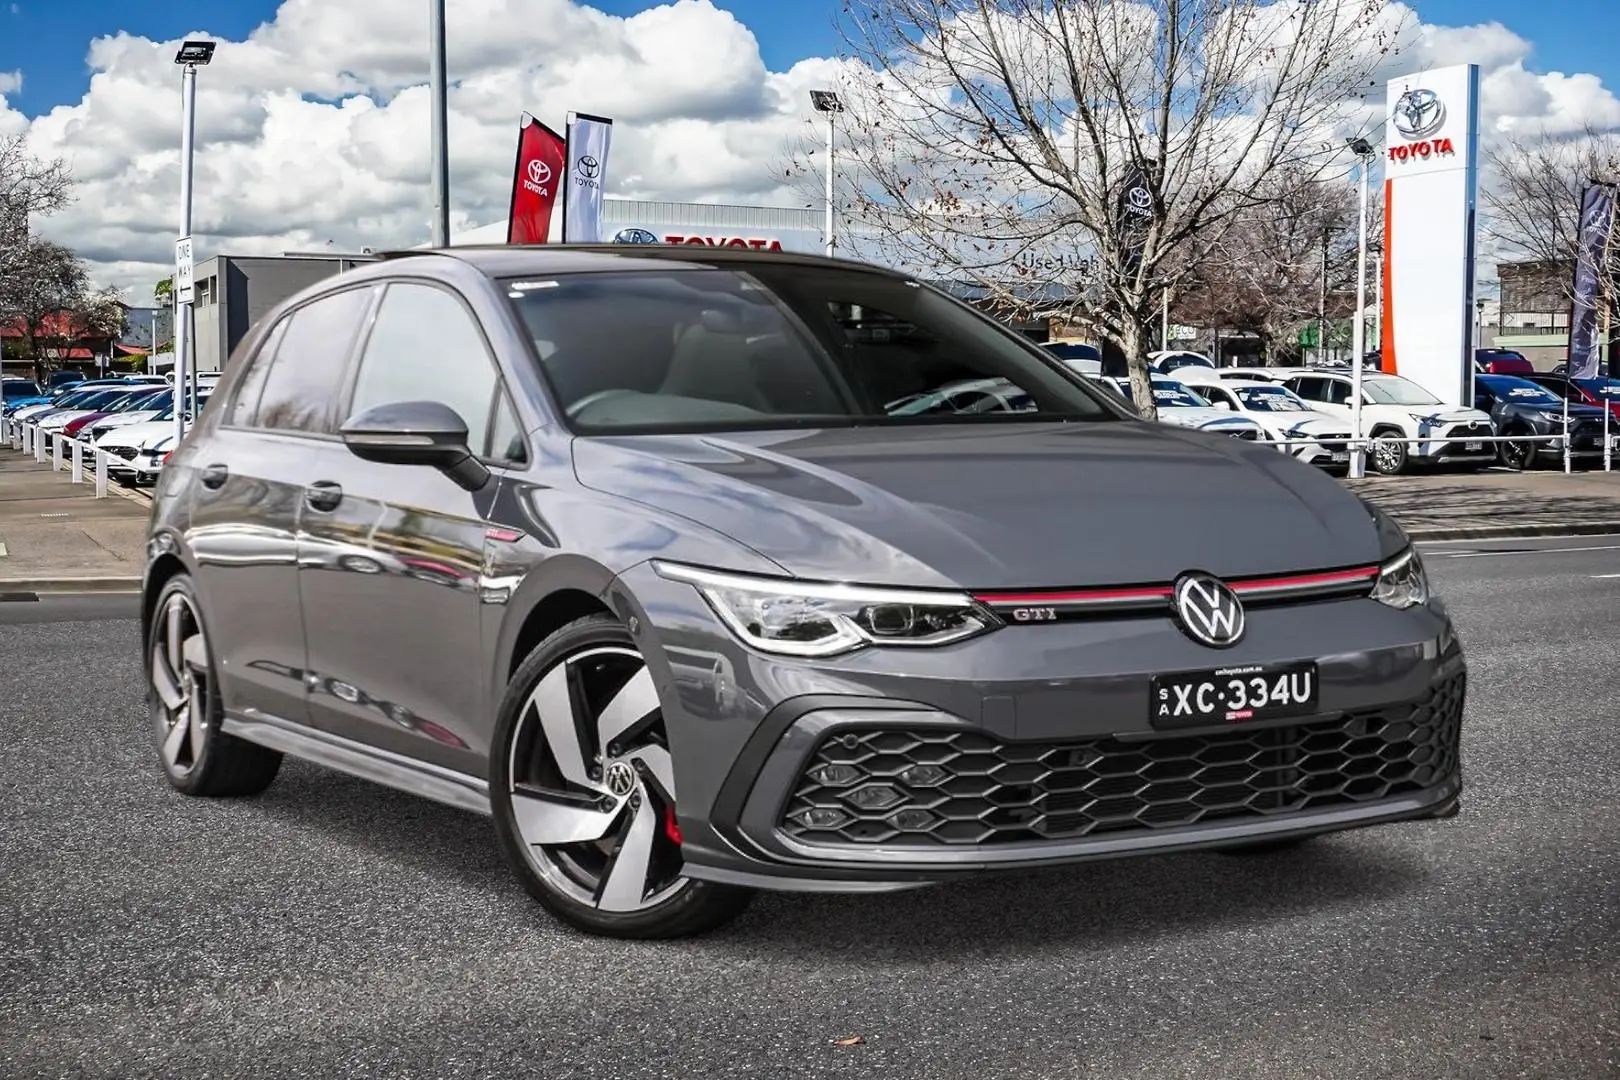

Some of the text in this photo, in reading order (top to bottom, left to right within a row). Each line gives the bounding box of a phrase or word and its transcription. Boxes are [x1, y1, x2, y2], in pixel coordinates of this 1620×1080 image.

[1388, 138, 1455, 161] TOYOTA
[523, 179, 548, 197] TOYOTA
[1124, 203, 1152, 217] TOYOTA
[178, 243, 190, 260] ONE
[179, 265, 191, 279] WAY
[1012, 607, 1057, 621] GTI
